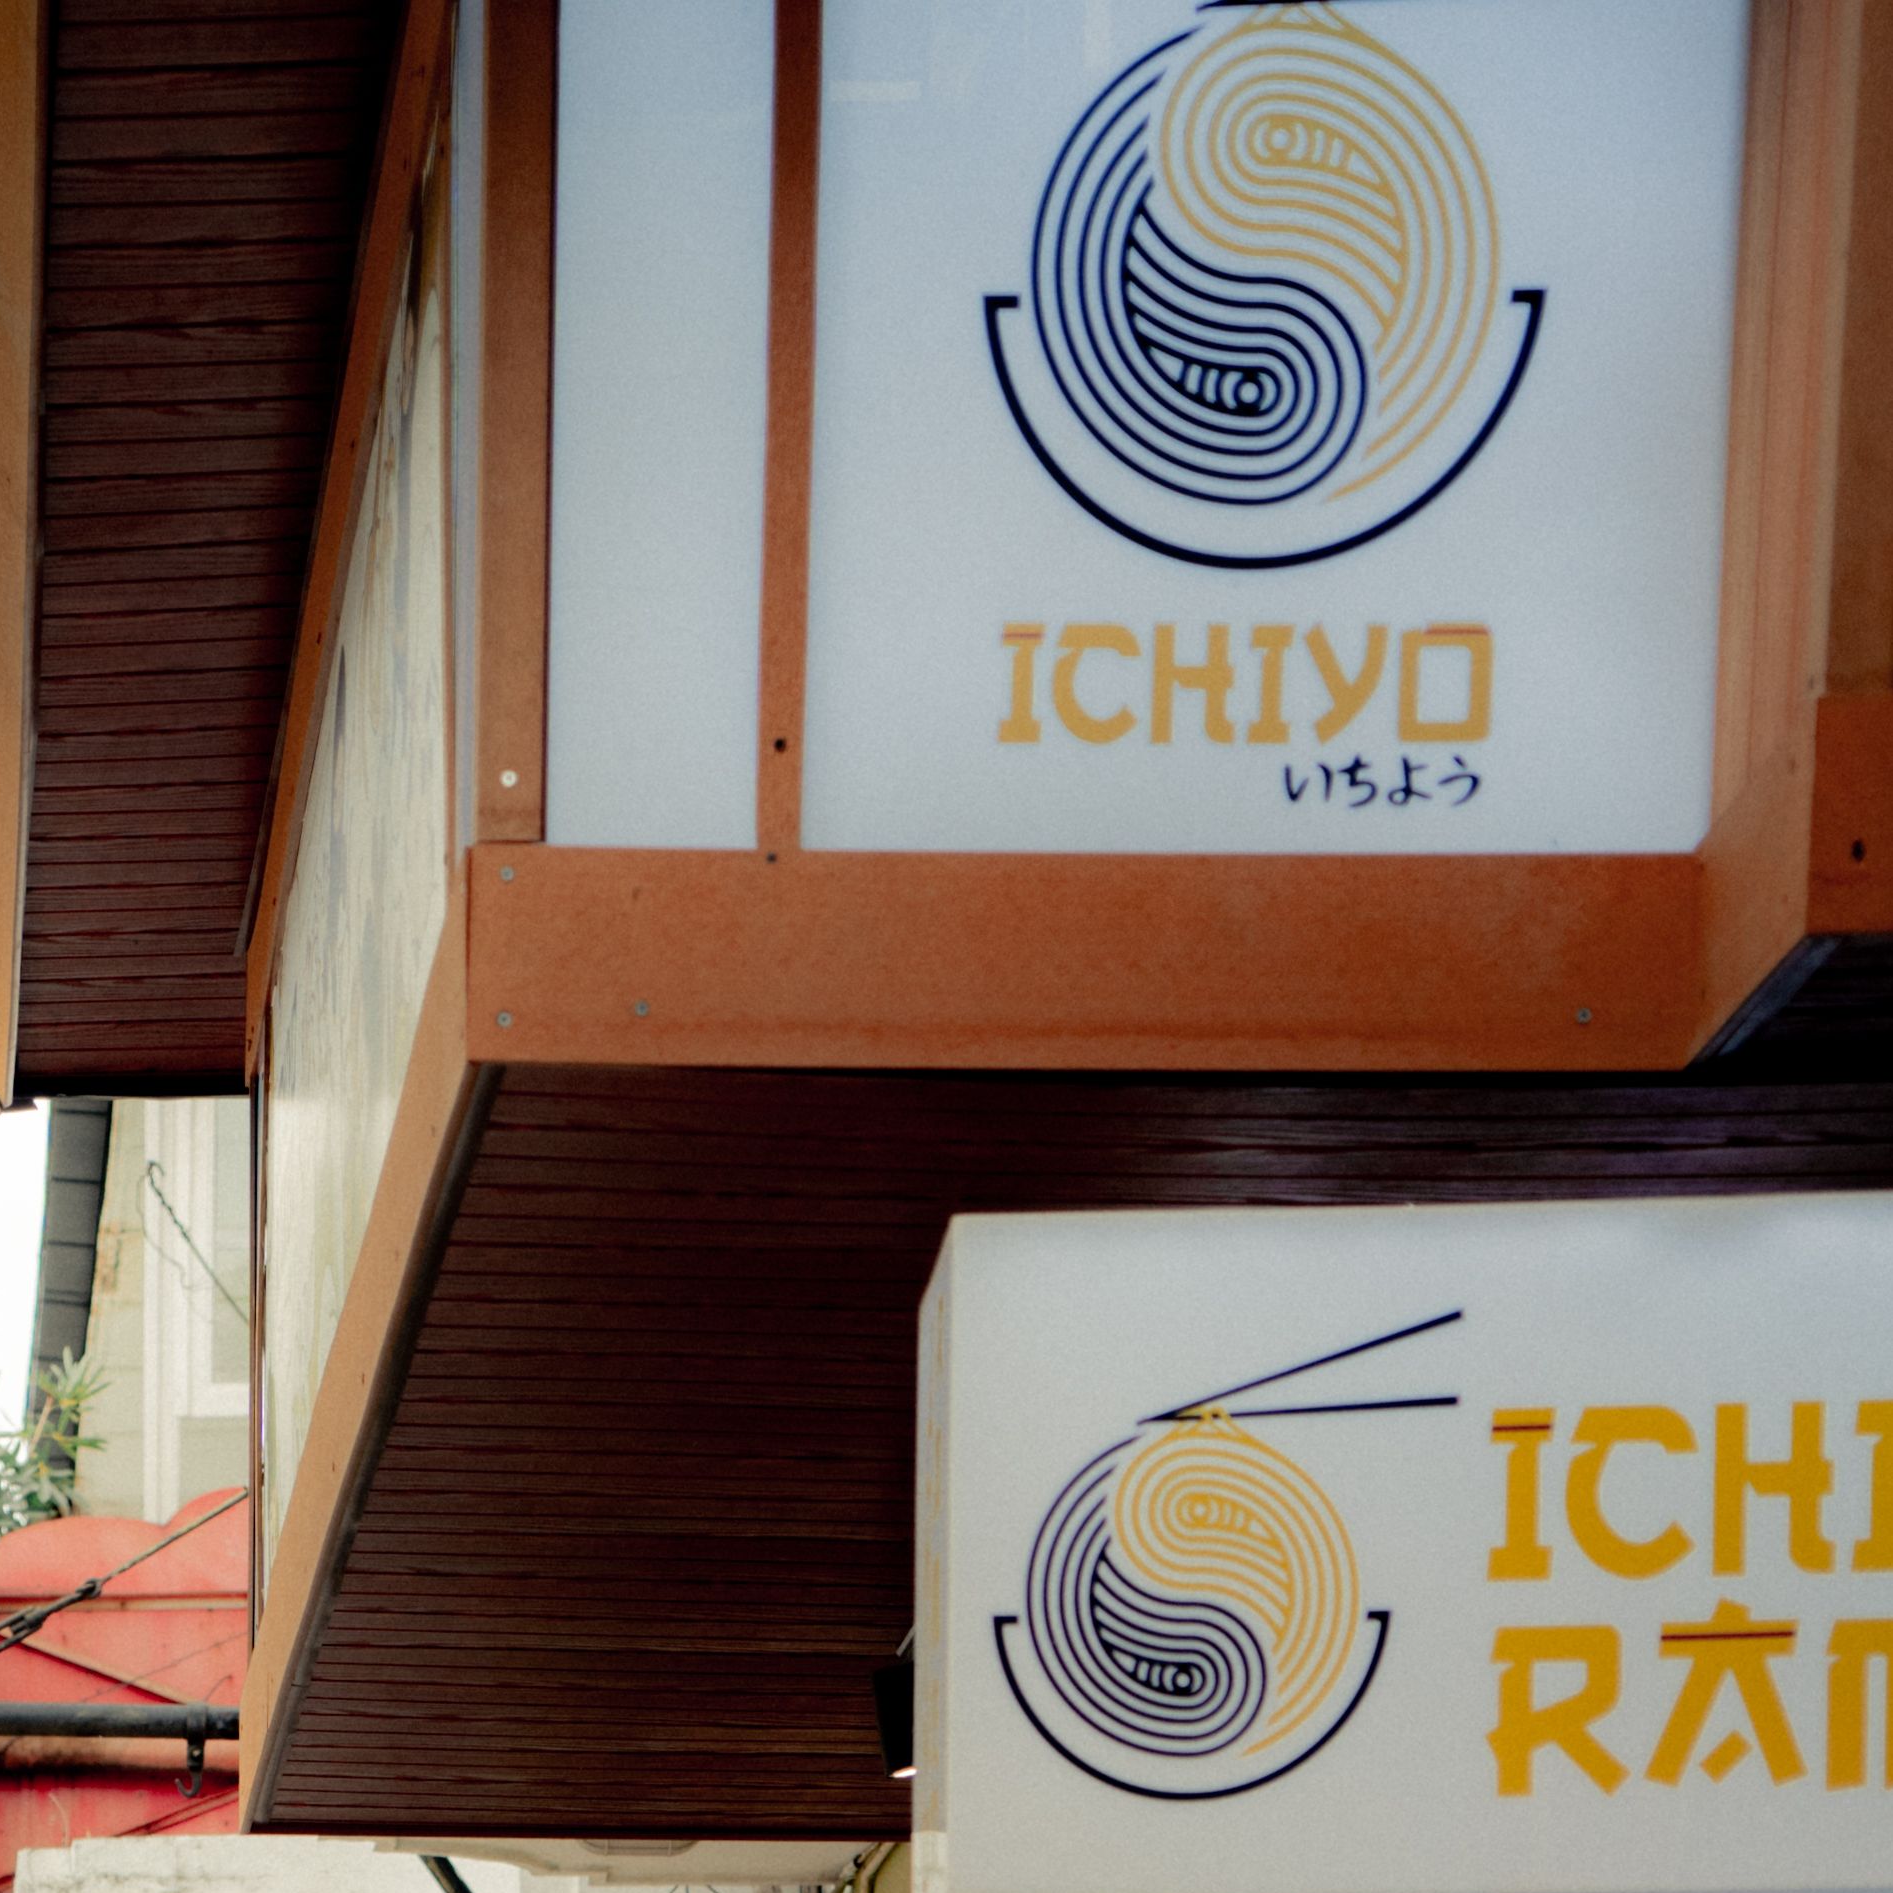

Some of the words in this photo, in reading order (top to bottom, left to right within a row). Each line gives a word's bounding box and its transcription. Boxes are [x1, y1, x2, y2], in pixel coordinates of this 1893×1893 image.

[999, 623, 1494, 745] ICHIYO
[1284, 756, 1482, 808] いちよう
